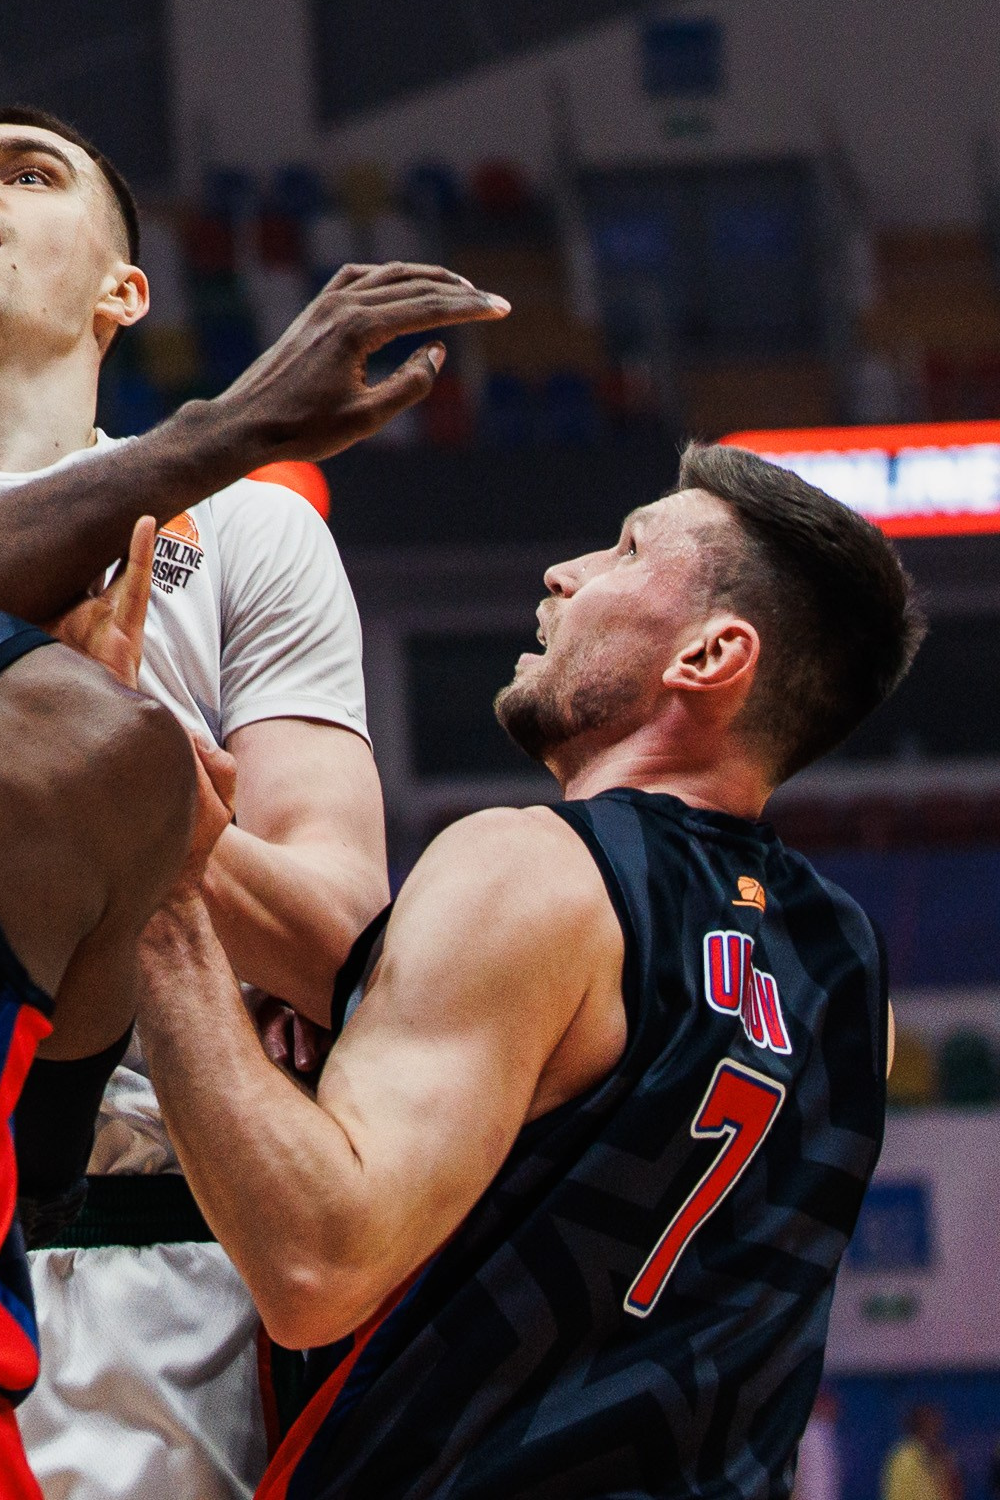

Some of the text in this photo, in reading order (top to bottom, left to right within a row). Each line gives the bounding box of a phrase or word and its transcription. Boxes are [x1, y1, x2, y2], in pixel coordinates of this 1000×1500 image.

[154, 537, 205, 570] INLINE
[152, 558, 194, 590] ASKET
[152, 578, 174, 595] CUP
[623, 1057, 786, 1319] 7
